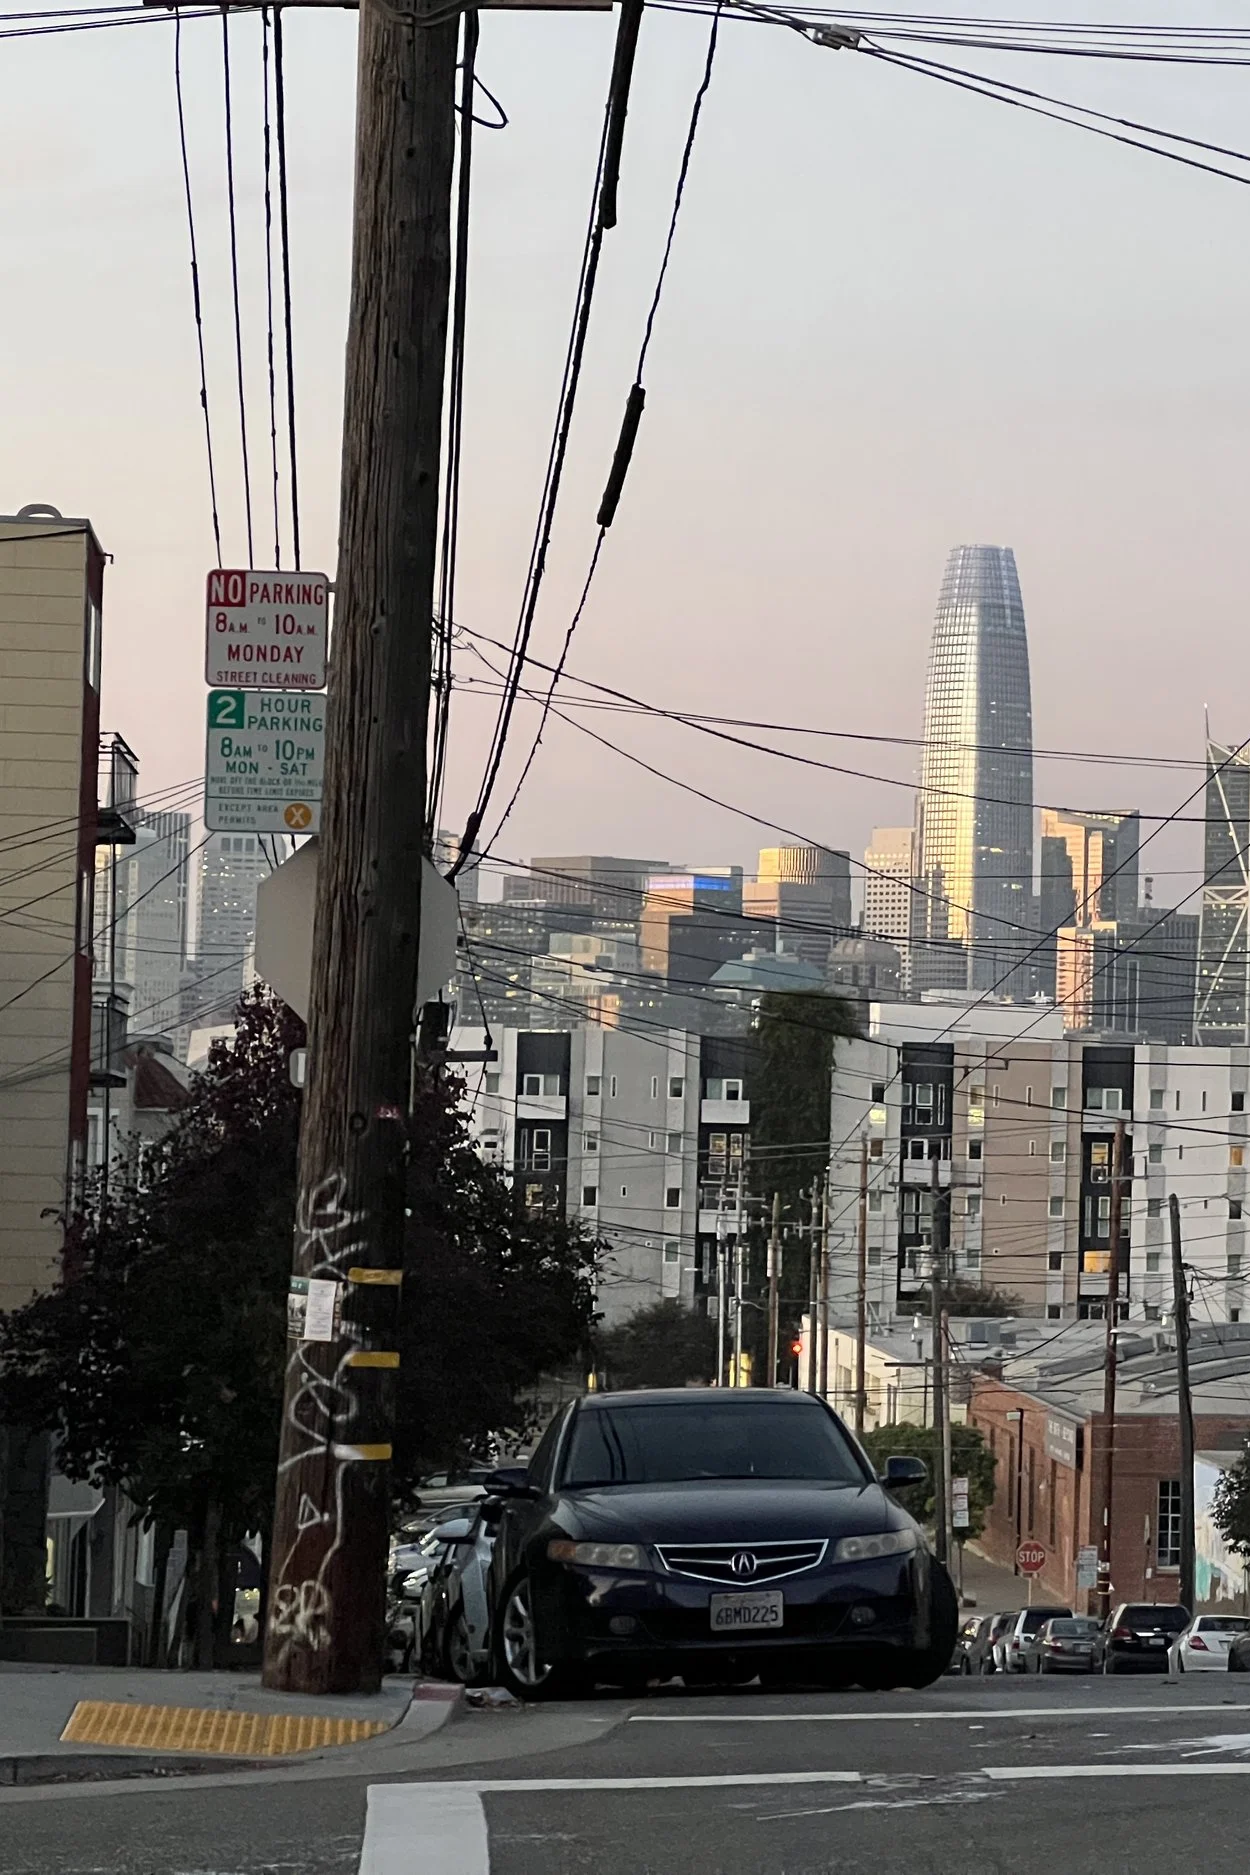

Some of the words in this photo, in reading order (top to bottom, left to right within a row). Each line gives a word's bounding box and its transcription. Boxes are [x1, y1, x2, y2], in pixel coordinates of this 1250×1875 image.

[211, 574, 243, 604] NO
[250, 582, 325, 606] PARKING
[227, 644, 304, 663] MONDAY
[216, 670, 258, 684] STREET
[261, 672, 317, 685] CLEANING
[215, 695, 238, 725] 2
[260, 697, 312, 714] HOUR
[247, 715, 323, 733] PARKING
[257, 743, 269, 753] TO
[225, 761, 260, 775] MON
[279, 762, 309, 777] SAT
[290, 806, 305, 826] X
[1019, 1551, 1044, 1563] STOP
[715, 1605, 778, 1625] 6BMD225
